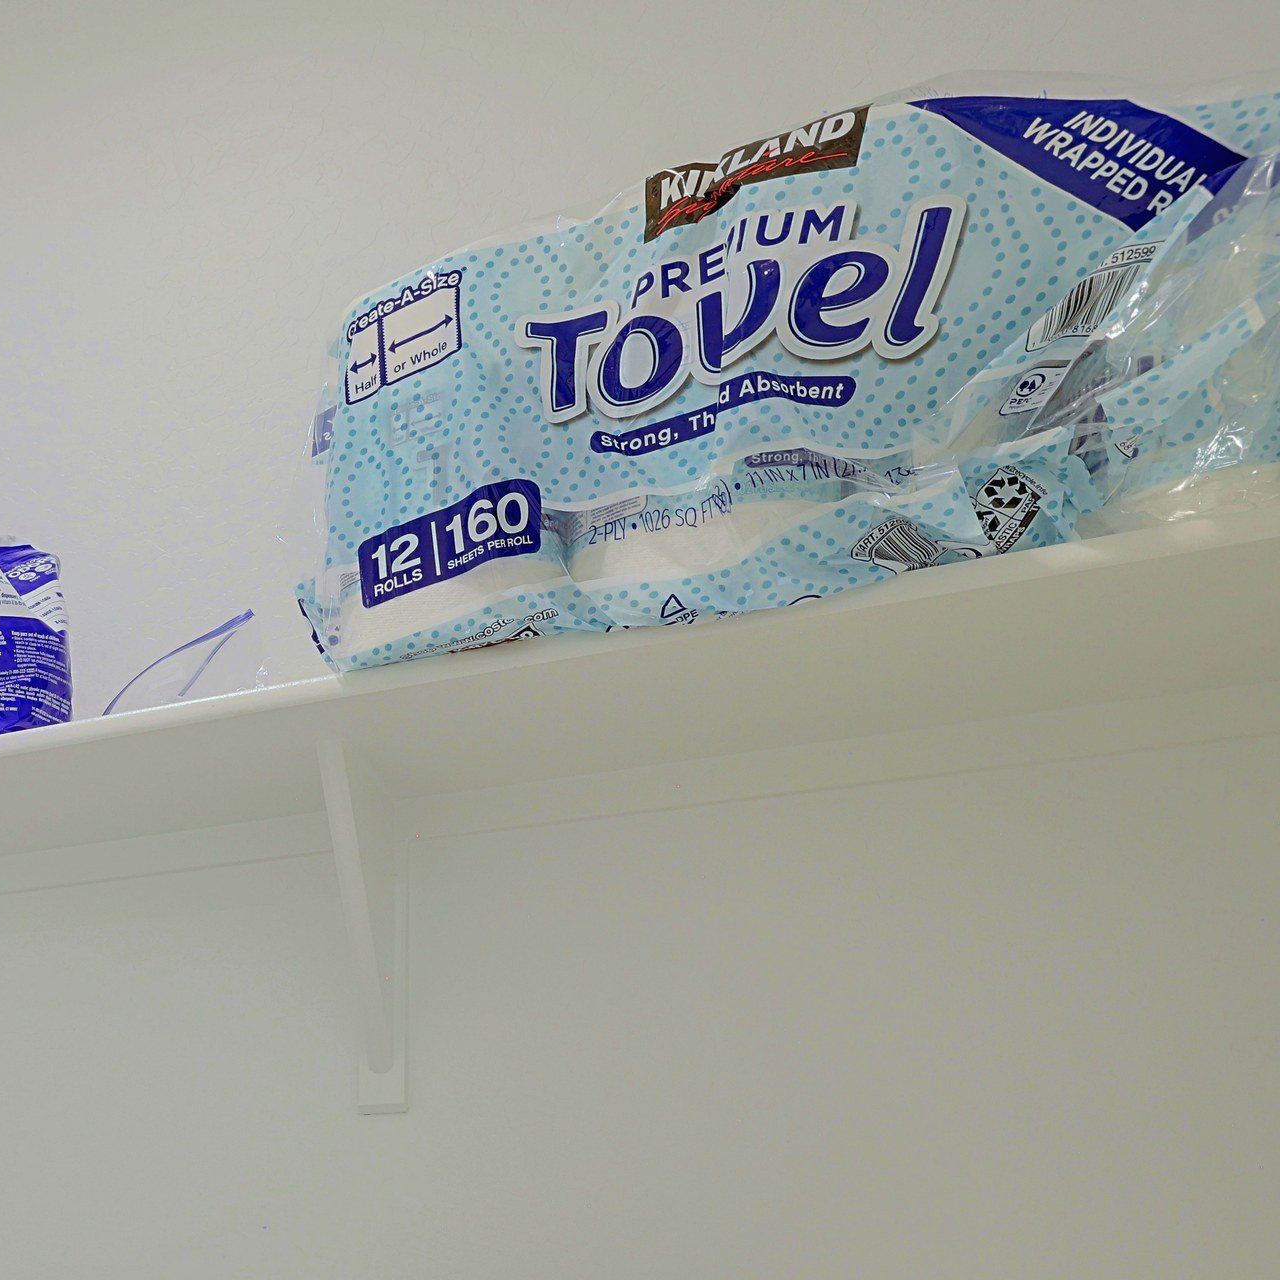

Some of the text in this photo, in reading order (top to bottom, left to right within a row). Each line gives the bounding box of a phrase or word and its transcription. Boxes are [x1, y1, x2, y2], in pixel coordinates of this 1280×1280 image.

[1023, 117, 1149, 201] WRAPPED
[1111, 245, 1157, 264] 512599
[347, 271, 460, 340] Create-A-Size
[354, 374, 378, 395] Half
[393, 341, 448, 374] or Whole
[600, 425, 679, 451] Strong,
[739, 378, 844, 401] Absorbent
[588, 517, 627, 545] 2-PLY
[639, 508, 671, 535] 1026
[675, 507, 698, 528] SQ
[764, 467, 786, 483] IN
[810, 459, 829, 480] IN
[371, 533, 421, 579] 12
[445, 492, 529, 555] 160
[996, 522, 1017, 547] ASTIC
[373, 535, 533, 597] ROLLS SHEETS PER ROLL
[676, 609, 699, 624] DPE
